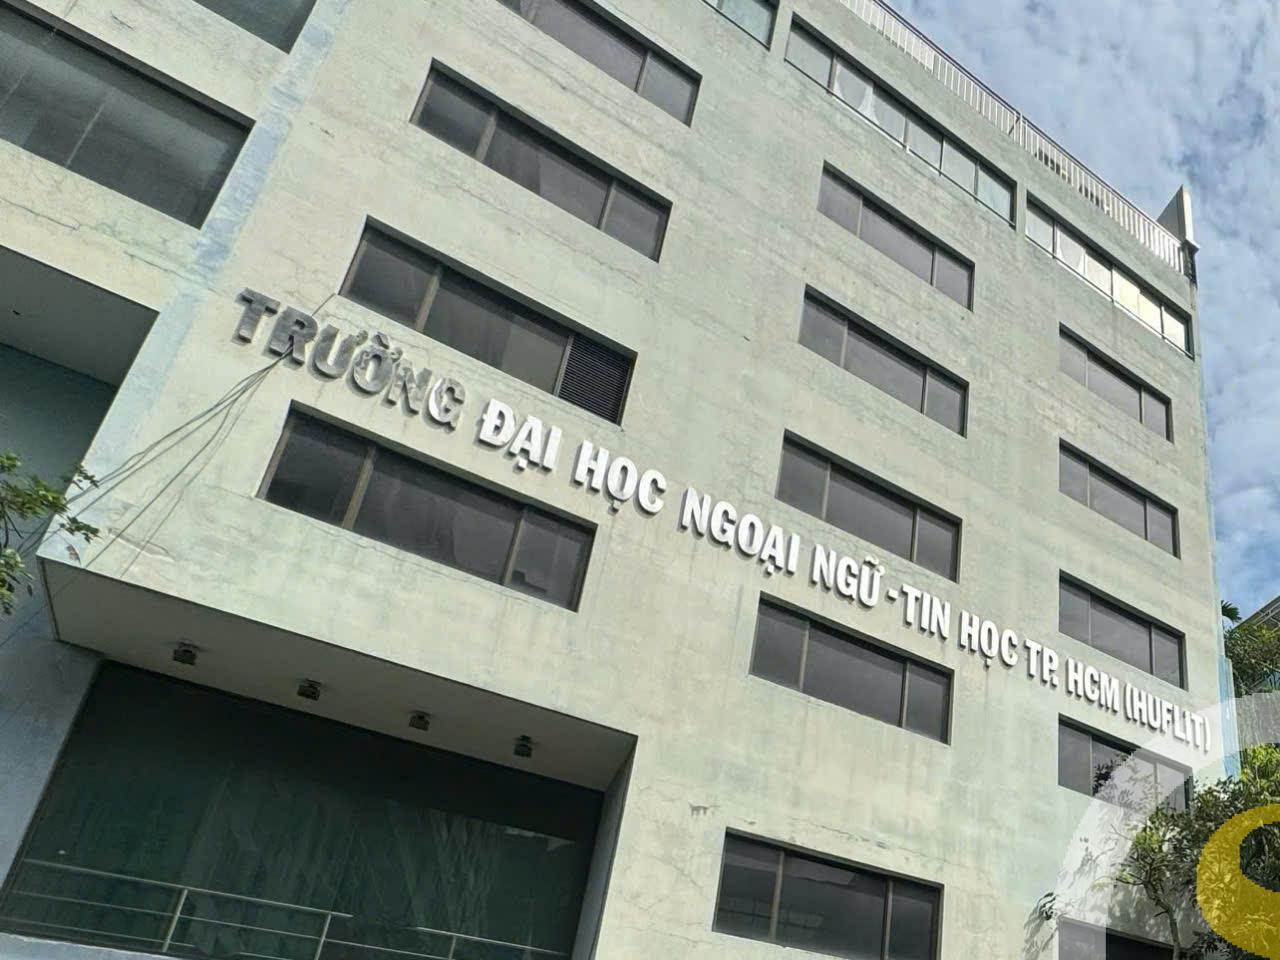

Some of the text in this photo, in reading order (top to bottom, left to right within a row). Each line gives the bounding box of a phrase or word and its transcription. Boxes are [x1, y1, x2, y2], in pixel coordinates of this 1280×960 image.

[231, 287, 466, 430] TRƯỜNG
[479, 398, 563, 472] ĐẠI
[574, 439, 668, 516] HỌC
[682, 486, 800, 576] NGOẠI
[812, 542, 886, 608] NGỮ
[900, 584, 952, 641] TIN
[960, 610, 1018, 668] HỌC
[1067, 656, 1121, 714] HCM
[1124, 686, 1212, 753] (HUFLIT)
